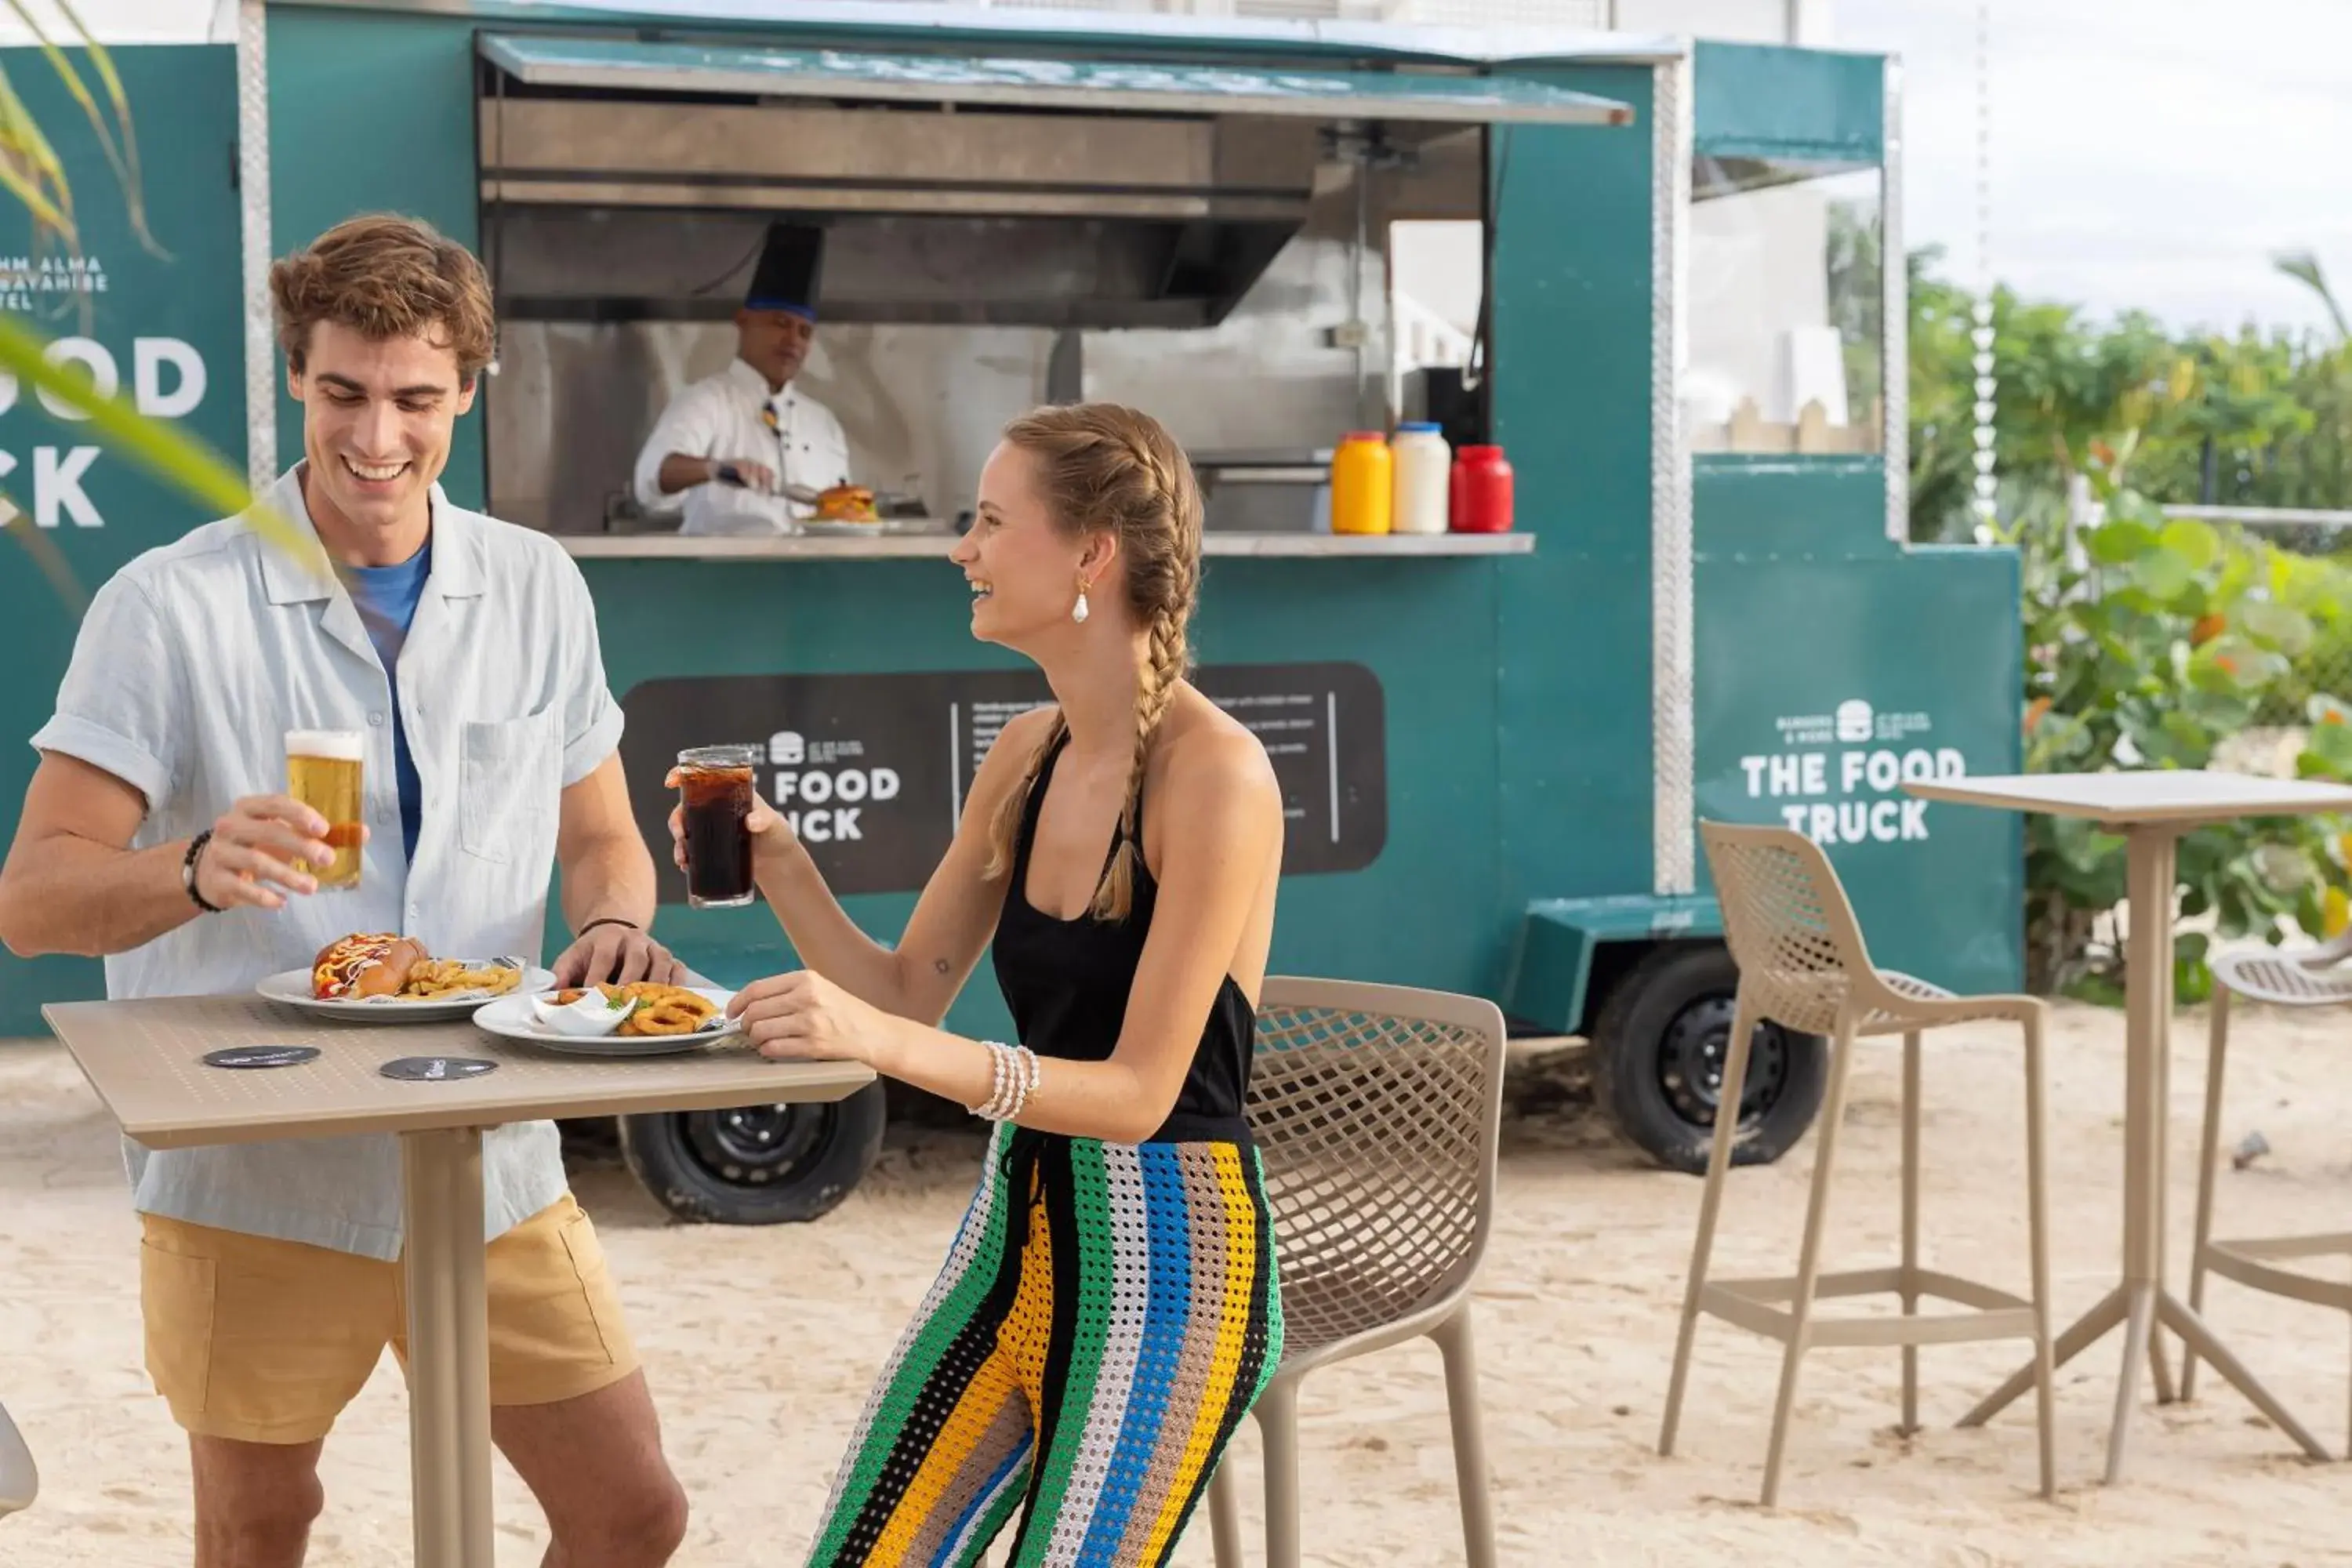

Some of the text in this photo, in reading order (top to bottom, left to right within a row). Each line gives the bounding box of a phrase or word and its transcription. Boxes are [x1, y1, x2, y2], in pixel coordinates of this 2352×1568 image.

[41, 256, 103, 274] ALMA
[0, 336, 207, 421] OD
[0, 445, 106, 528] K
[775, 768, 901, 805] FOOD
[1740, 747, 1966, 798] THE FOOD
[1780, 799, 1929, 844] TRUCK
